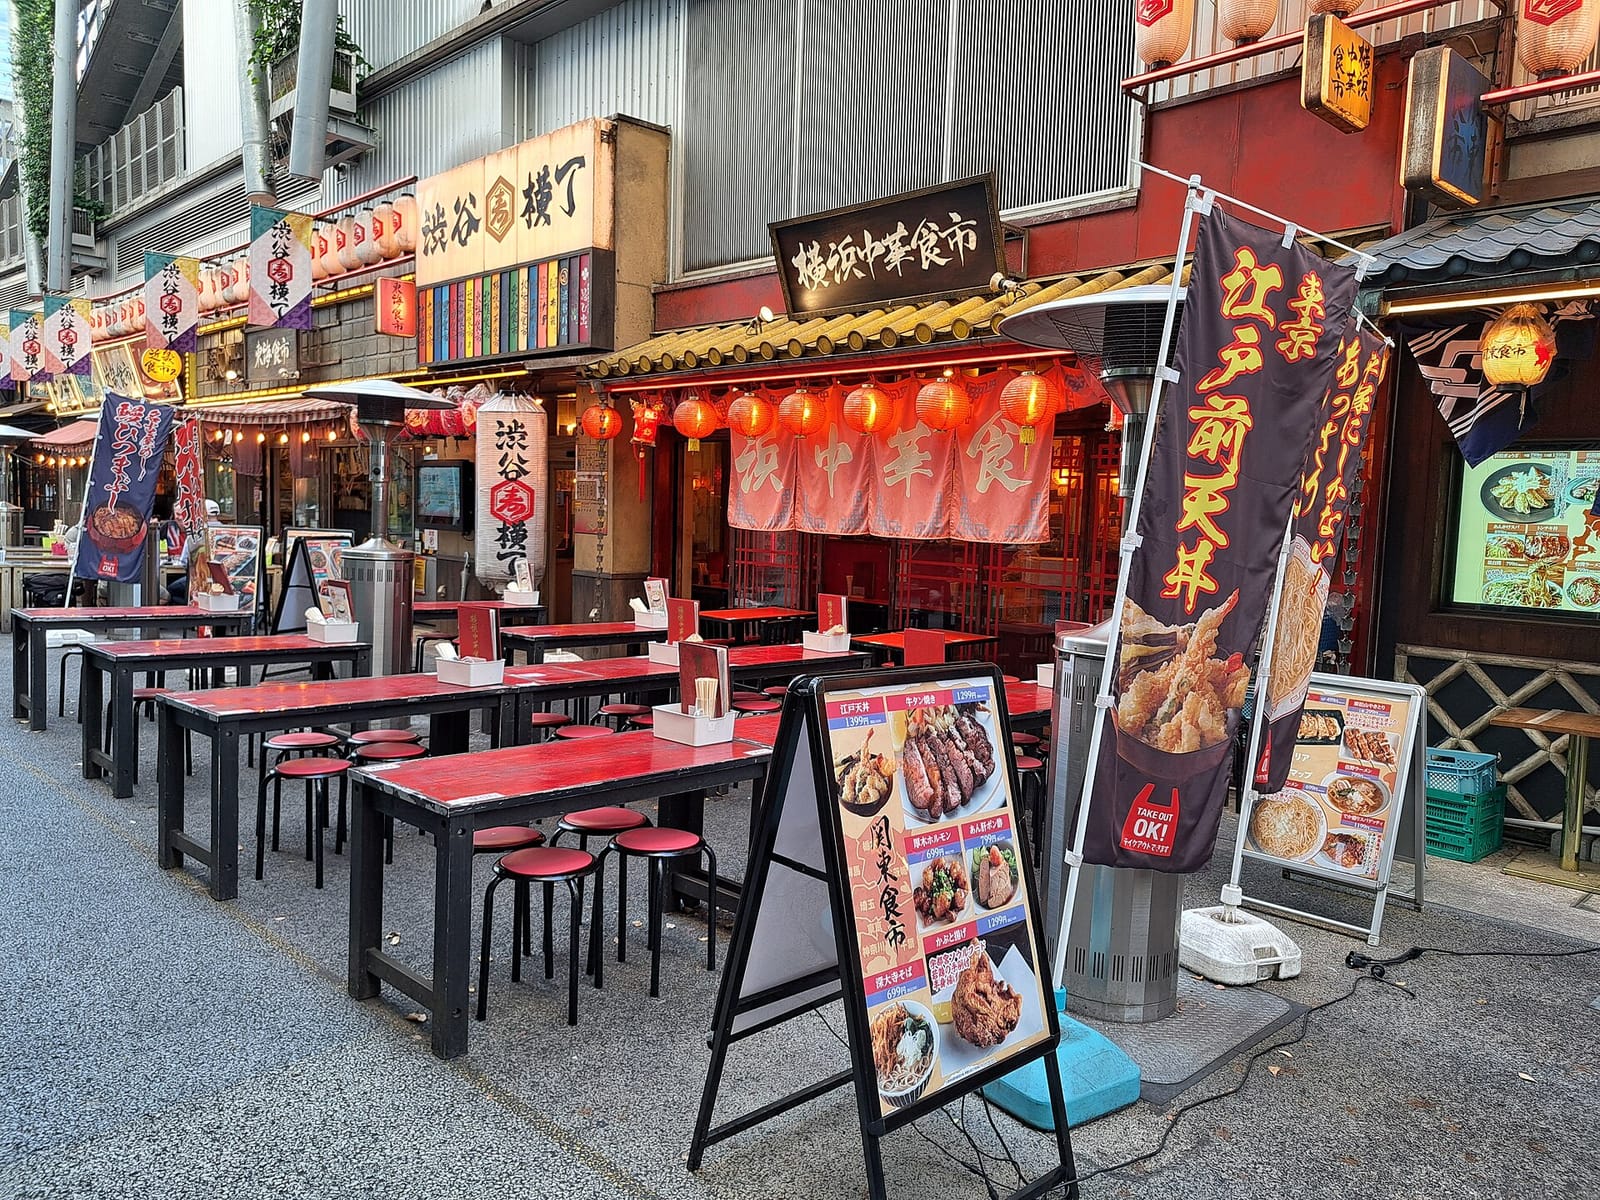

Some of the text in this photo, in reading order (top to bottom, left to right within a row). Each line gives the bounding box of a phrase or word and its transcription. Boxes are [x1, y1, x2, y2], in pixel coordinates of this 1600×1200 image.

[791, 211, 977, 291] 横浜中華食市
[1275, 270, 1326, 363] 東京
[1160, 245, 1284, 615] 江戸前天丼
[905, 694, 936, 707] 牛タン焼き
[956, 690, 977, 701] 1299円
[840, 701, 870, 715] 江戸天丼
[845, 715, 869, 728] 1399円
[1290, 768, 1313, 779] マップ
[1136, 806, 1174, 823] TAKE OUT
[1133, 818, 1169, 842] OK!
[913, 831, 952, 849] 厚木ホルモン
[980, 833, 998, 846] 799円
[1123, 837, 1170, 854] テイクアウトできます
[926, 847, 945, 860] 699円
[987, 915, 1008, 930] 1299円
[875, 965, 913, 990] 深大寺そば
[886, 986, 907, 1000] 699円
